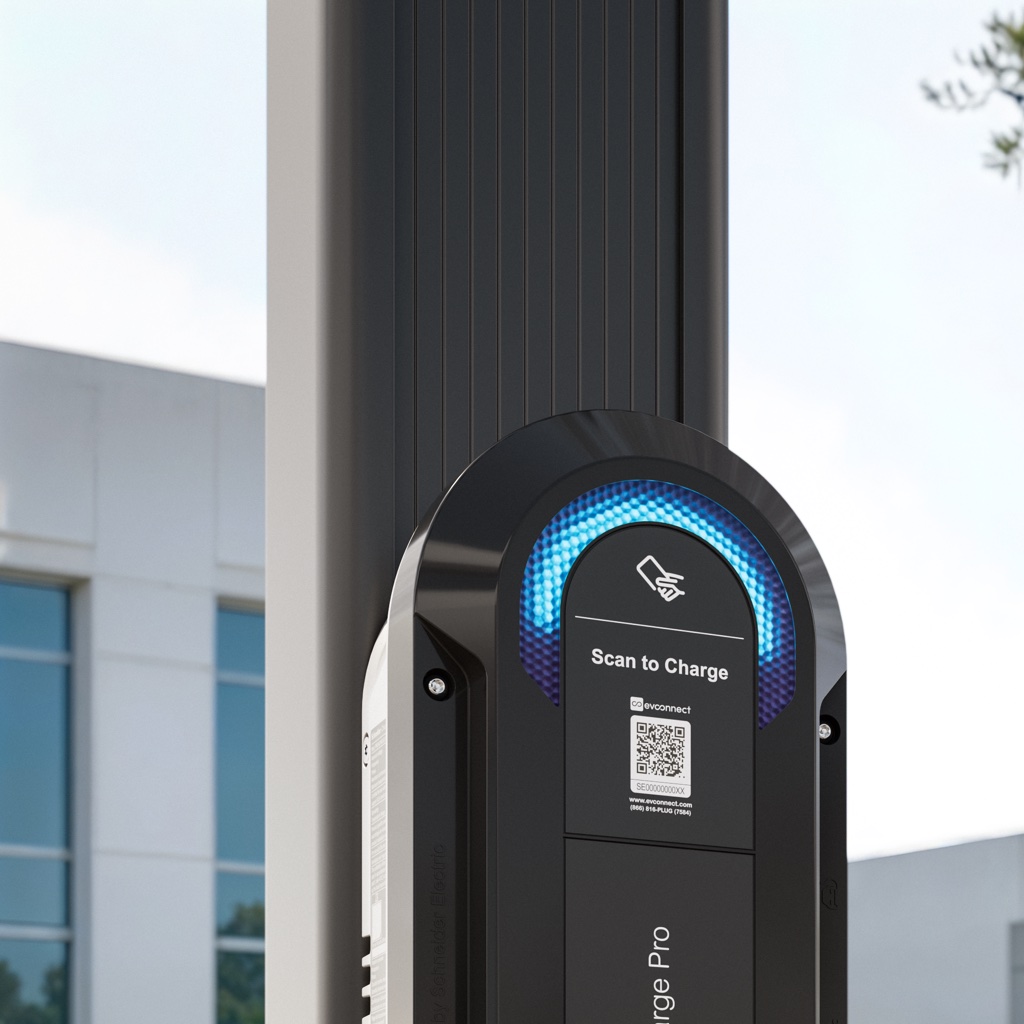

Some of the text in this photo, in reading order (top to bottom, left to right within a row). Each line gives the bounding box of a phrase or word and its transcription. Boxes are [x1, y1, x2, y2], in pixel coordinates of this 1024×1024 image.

[591, 648, 729, 682] Scan to Charge
[644, 702, 691, 714] evconnect
[629, 797, 692, 808] www.evconnect.com
[429, 843, 446, 907] Electric
[429, 912, 447, 997] Schneider
[648, 926, 670, 969] Pro
[429, 1002, 450, 1024] by
